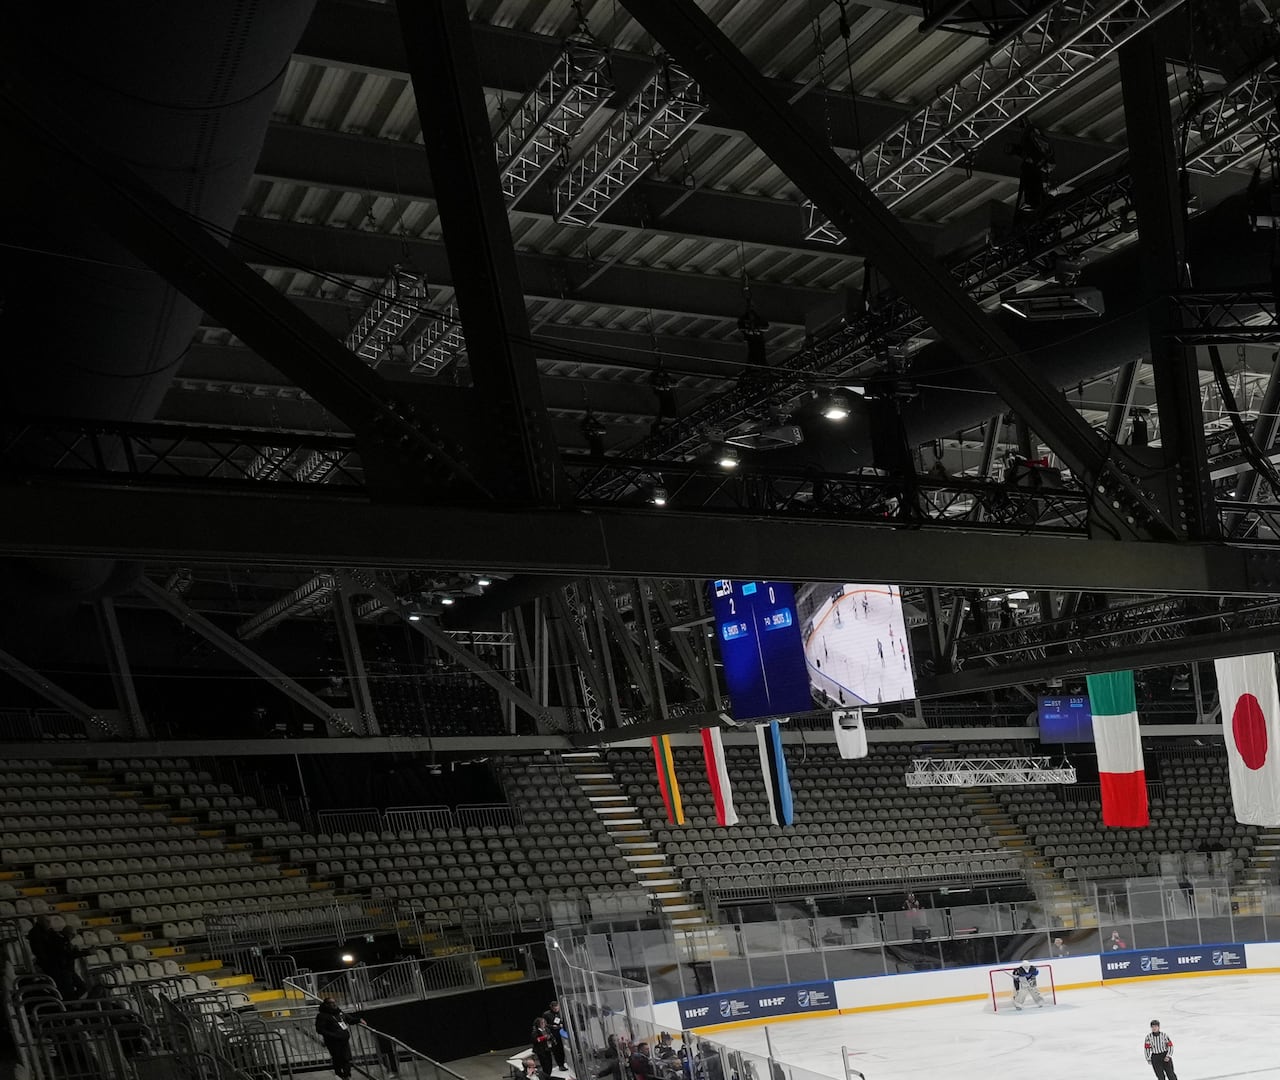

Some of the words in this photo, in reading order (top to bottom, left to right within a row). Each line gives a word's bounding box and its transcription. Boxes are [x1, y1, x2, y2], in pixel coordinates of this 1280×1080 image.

[729, 598, 736, 615] 2
[1107, 961, 1131, 970] IIHF
[1178, 956, 1202, 964] IIHF
[759, 996, 786, 1007] IIHF
[685, 1006, 709, 1018] IIHF
